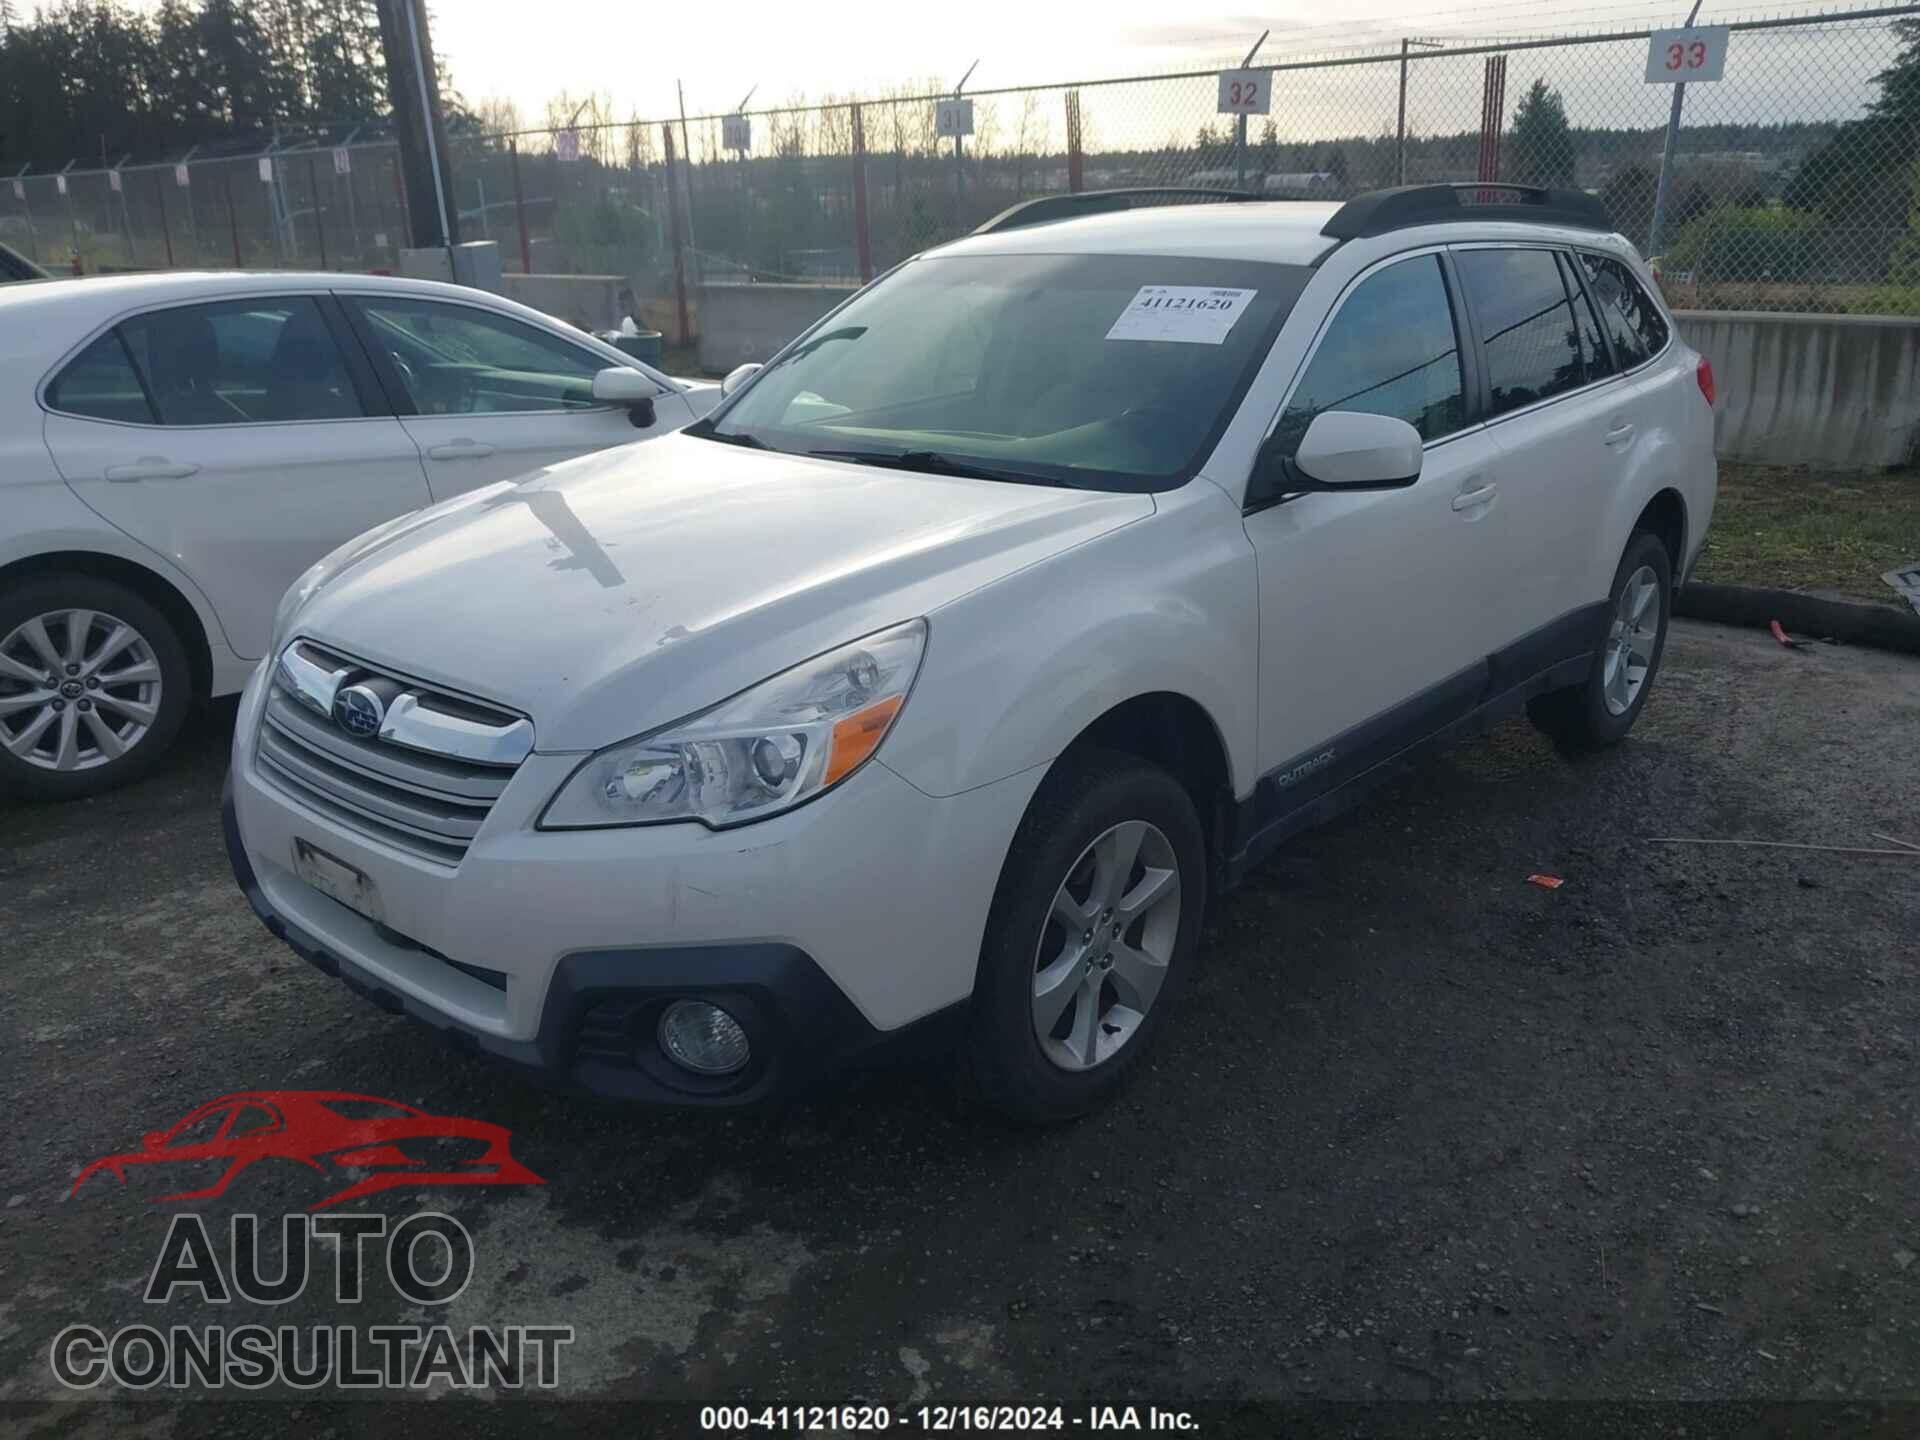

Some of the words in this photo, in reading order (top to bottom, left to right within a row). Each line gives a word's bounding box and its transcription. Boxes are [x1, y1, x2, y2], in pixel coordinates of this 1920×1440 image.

[1665, 42, 1706, 70] 33
[1230, 80, 1257, 105] 32
[943, 109, 960, 129] 31
[1140, 298, 1233, 310] 41121620
[1279, 747, 1336, 786] OUTBACK
